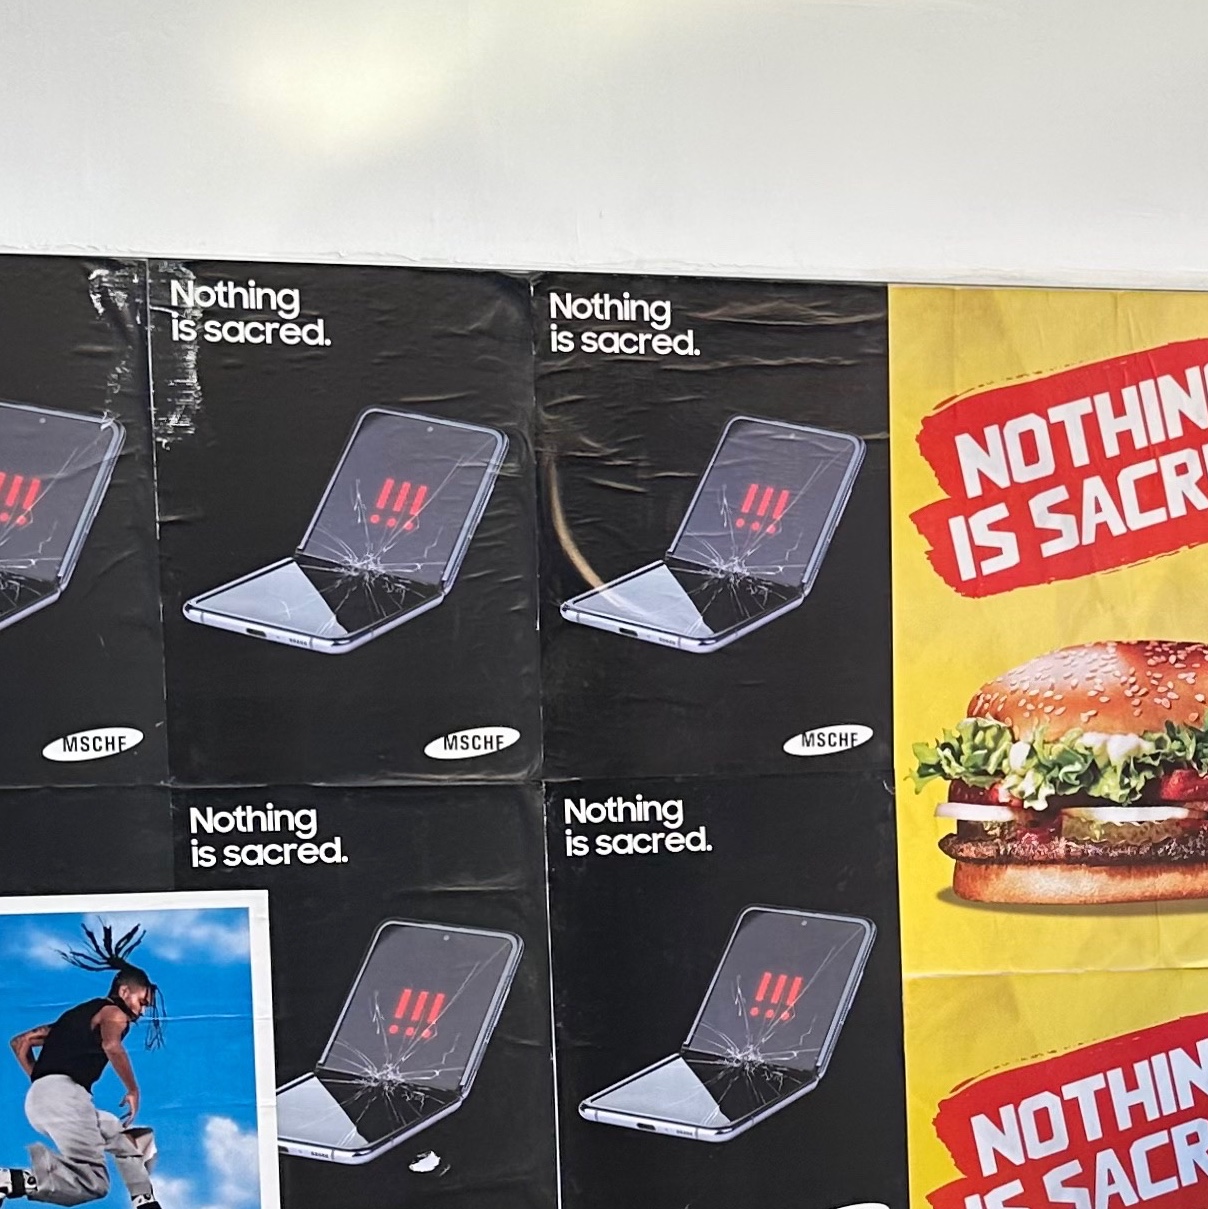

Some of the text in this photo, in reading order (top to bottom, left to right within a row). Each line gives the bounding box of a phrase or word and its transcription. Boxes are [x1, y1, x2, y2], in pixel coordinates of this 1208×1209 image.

[170, 279, 300, 318] Nothing
[549, 292, 671, 329] Nothing
[171, 316, 332, 347] is sacred.
[550, 326, 700, 356] is sacred.
[948, 503, 1020, 581] IS
[62, 735, 128, 753] MSCHF
[443, 733, 505, 752] MSCHF
[801, 730, 859, 748] MSCHF
[189, 803, 318, 839] Nothing
[564, 794, 683, 828] Nothing
[191, 837, 349, 867] is sacred.
[565, 826, 713, 856] is sacred.
